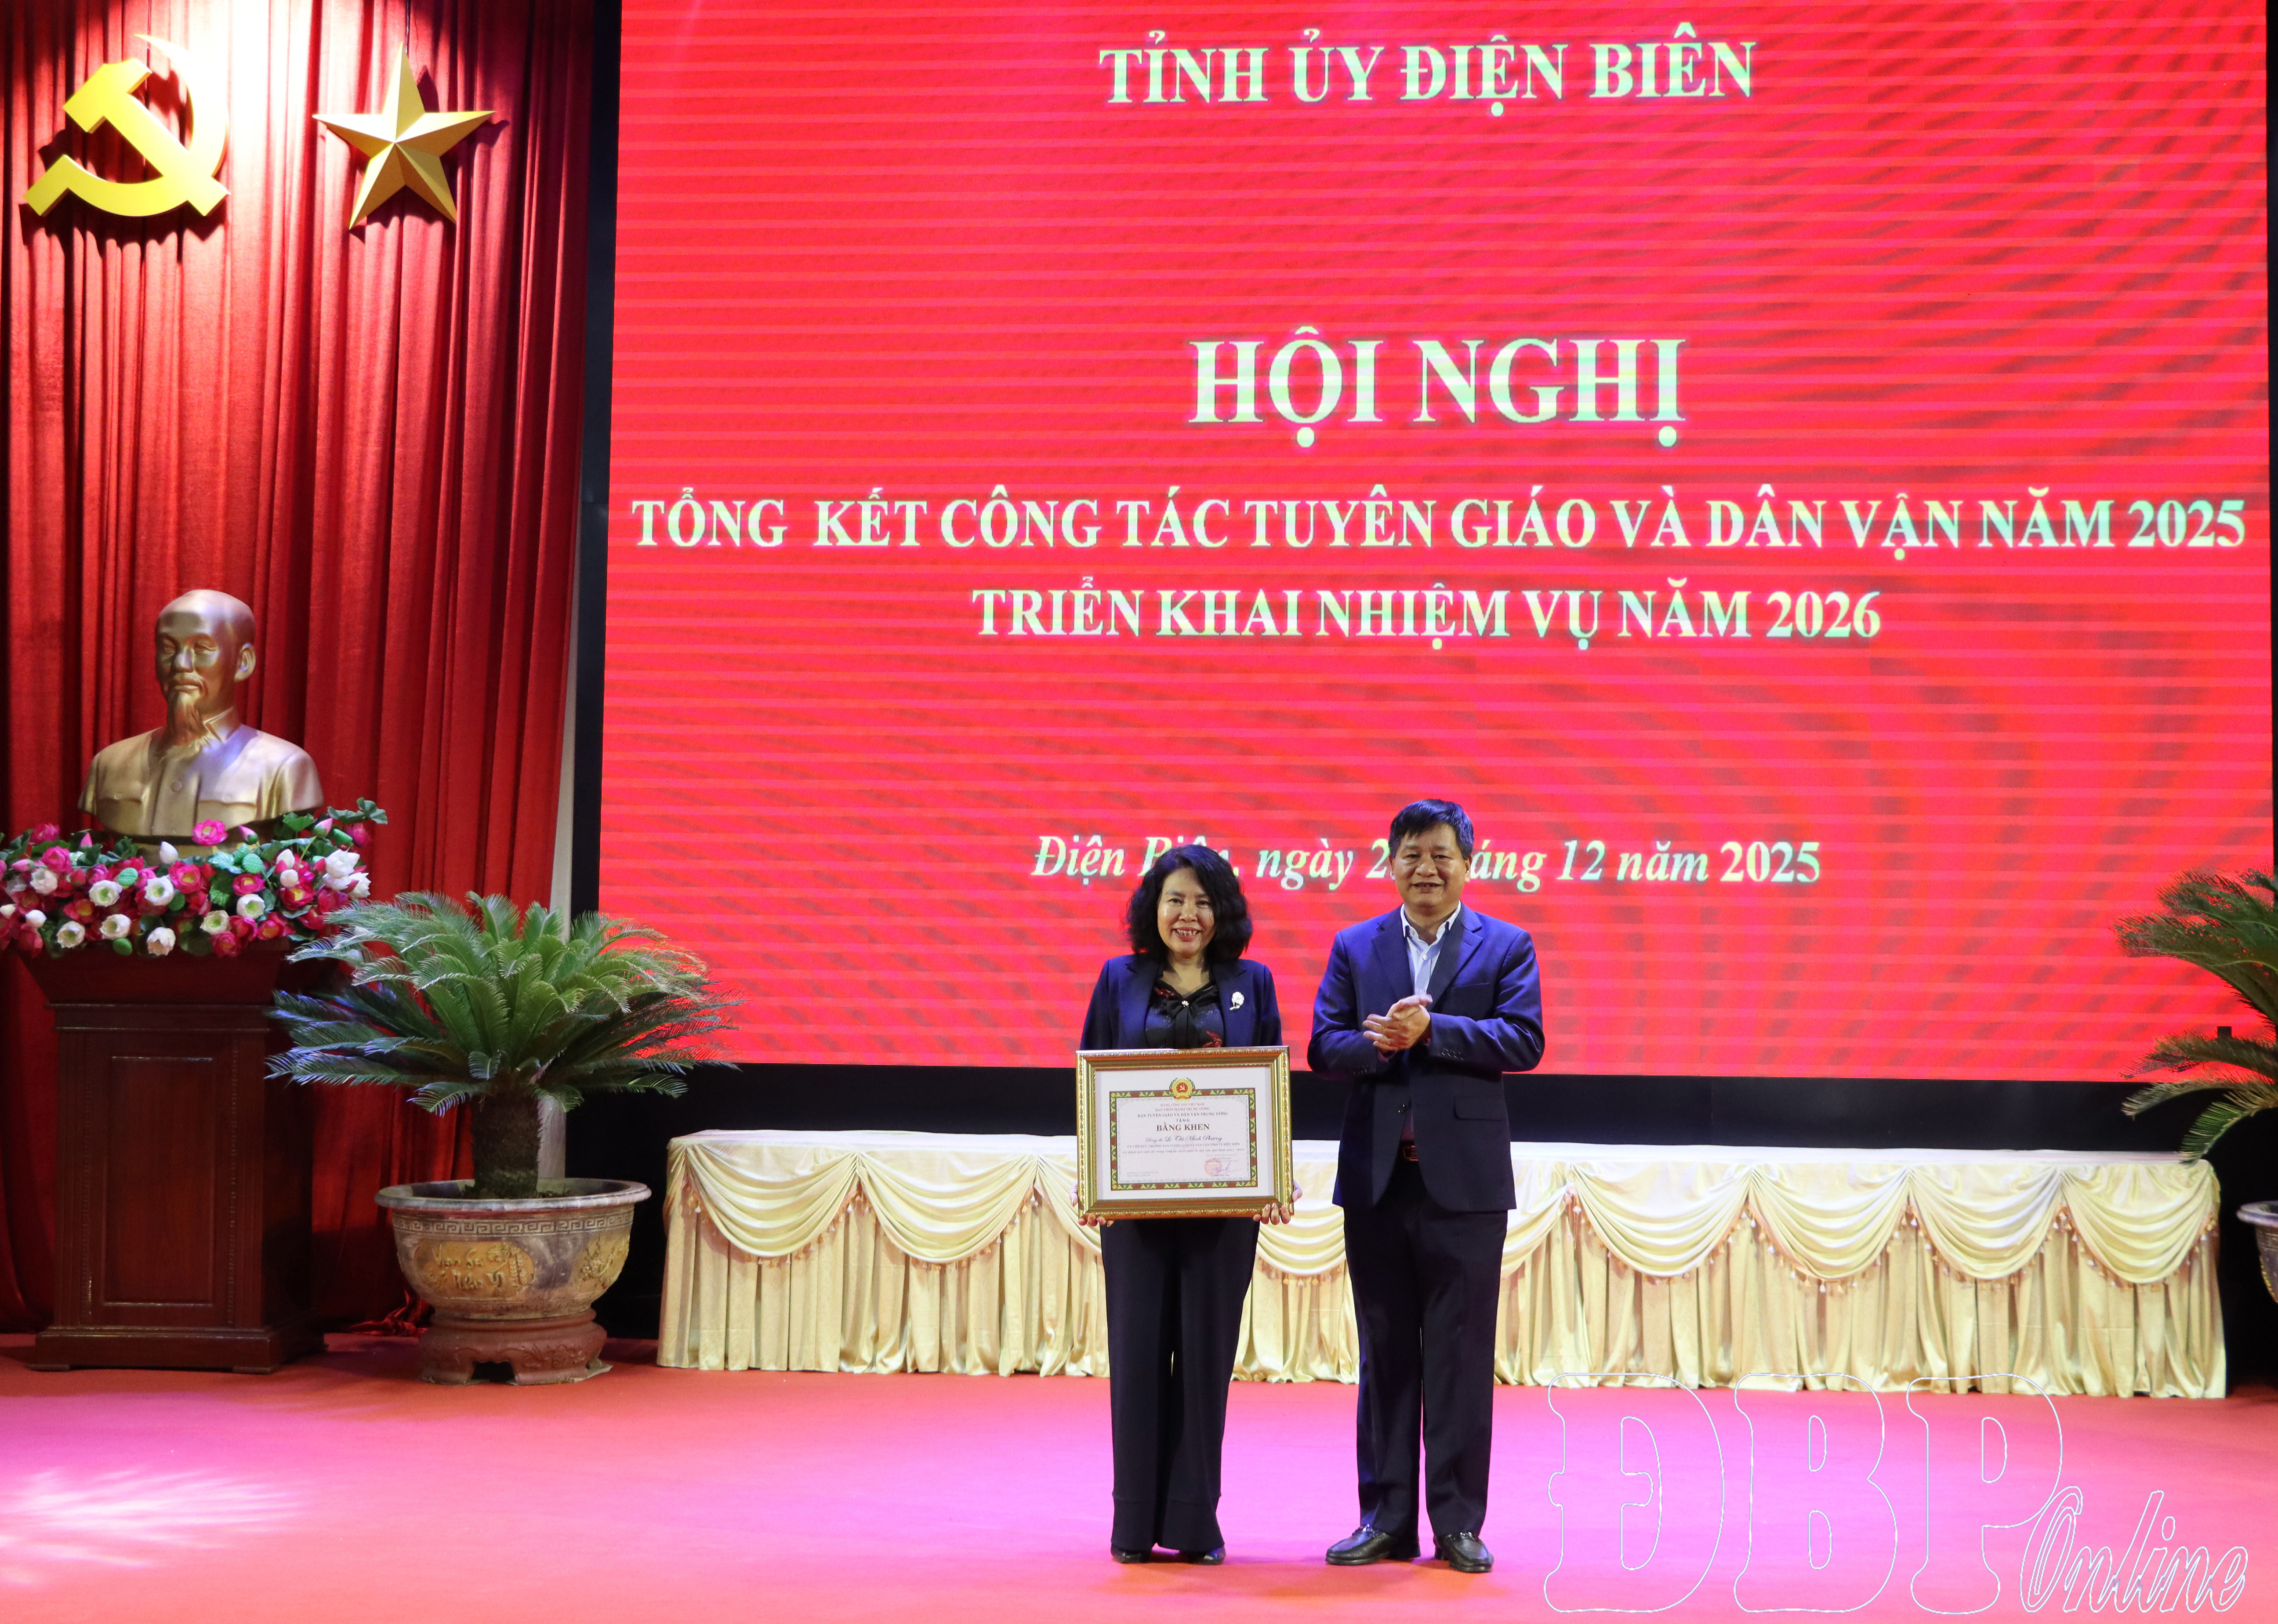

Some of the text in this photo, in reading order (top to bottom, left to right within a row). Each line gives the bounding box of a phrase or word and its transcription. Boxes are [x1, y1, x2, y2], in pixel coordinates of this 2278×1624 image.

[1099, 22, 1756, 116] TỈNH ỦY ĐIỆN BIÊN
[1188, 326, 1686, 448] HỘI NGHỊ
[631, 484, 2245, 561] TỔNG KẾT CÔNG TÁC TUYÊN GIÁO VÀ DÂN VẬN NĂM 2025
[972, 576, 1881, 651] TRIỂN KHAI NHIỆM VỤ NĂM 2026
[1031, 834, 1126, 885] Điện
[1256, 837, 1354, 891] ngày
[1366, 838, 1391, 878] 2
[1470, 839, 1547, 892] áng
[1556, 840, 1606, 881] 12
[1616, 841, 1709, 882] năm
[1720, 841, 1821, 883] 2025
[1156, 1121, 1181, 1131] BẰNG
